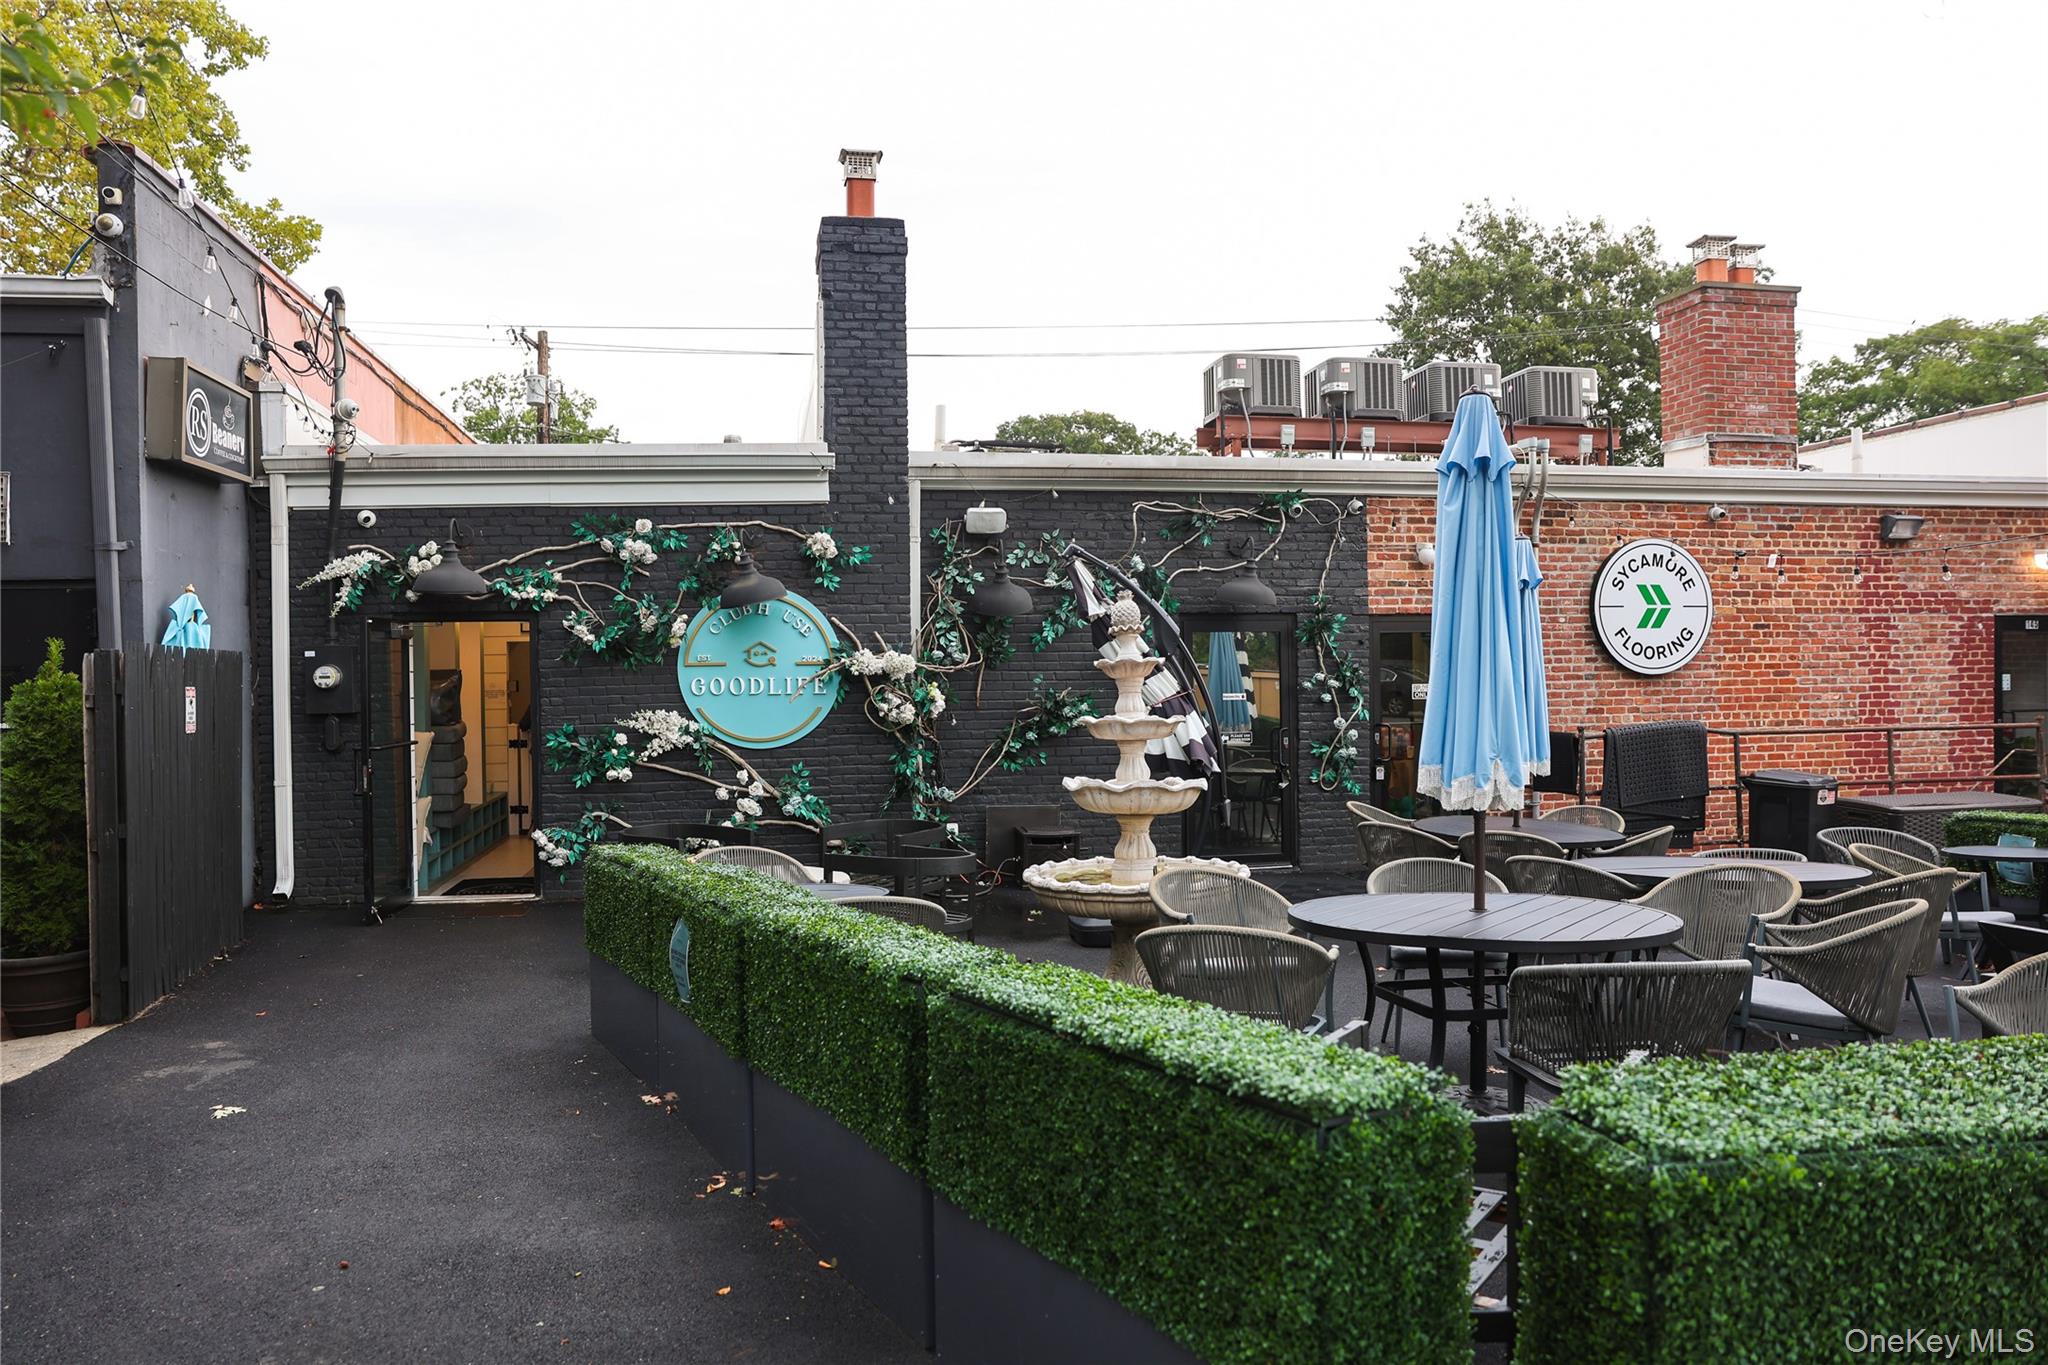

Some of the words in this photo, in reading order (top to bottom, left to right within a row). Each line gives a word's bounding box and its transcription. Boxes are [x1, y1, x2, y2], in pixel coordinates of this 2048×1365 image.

[191, 405, 207, 440] RS
[212, 422, 245, 456] Beanery
[1612, 553, 1696, 592] SYCAMORE
[1614, 627, 1694, 660] FLOORING
[690, 676, 827, 697] GOODLIFE
